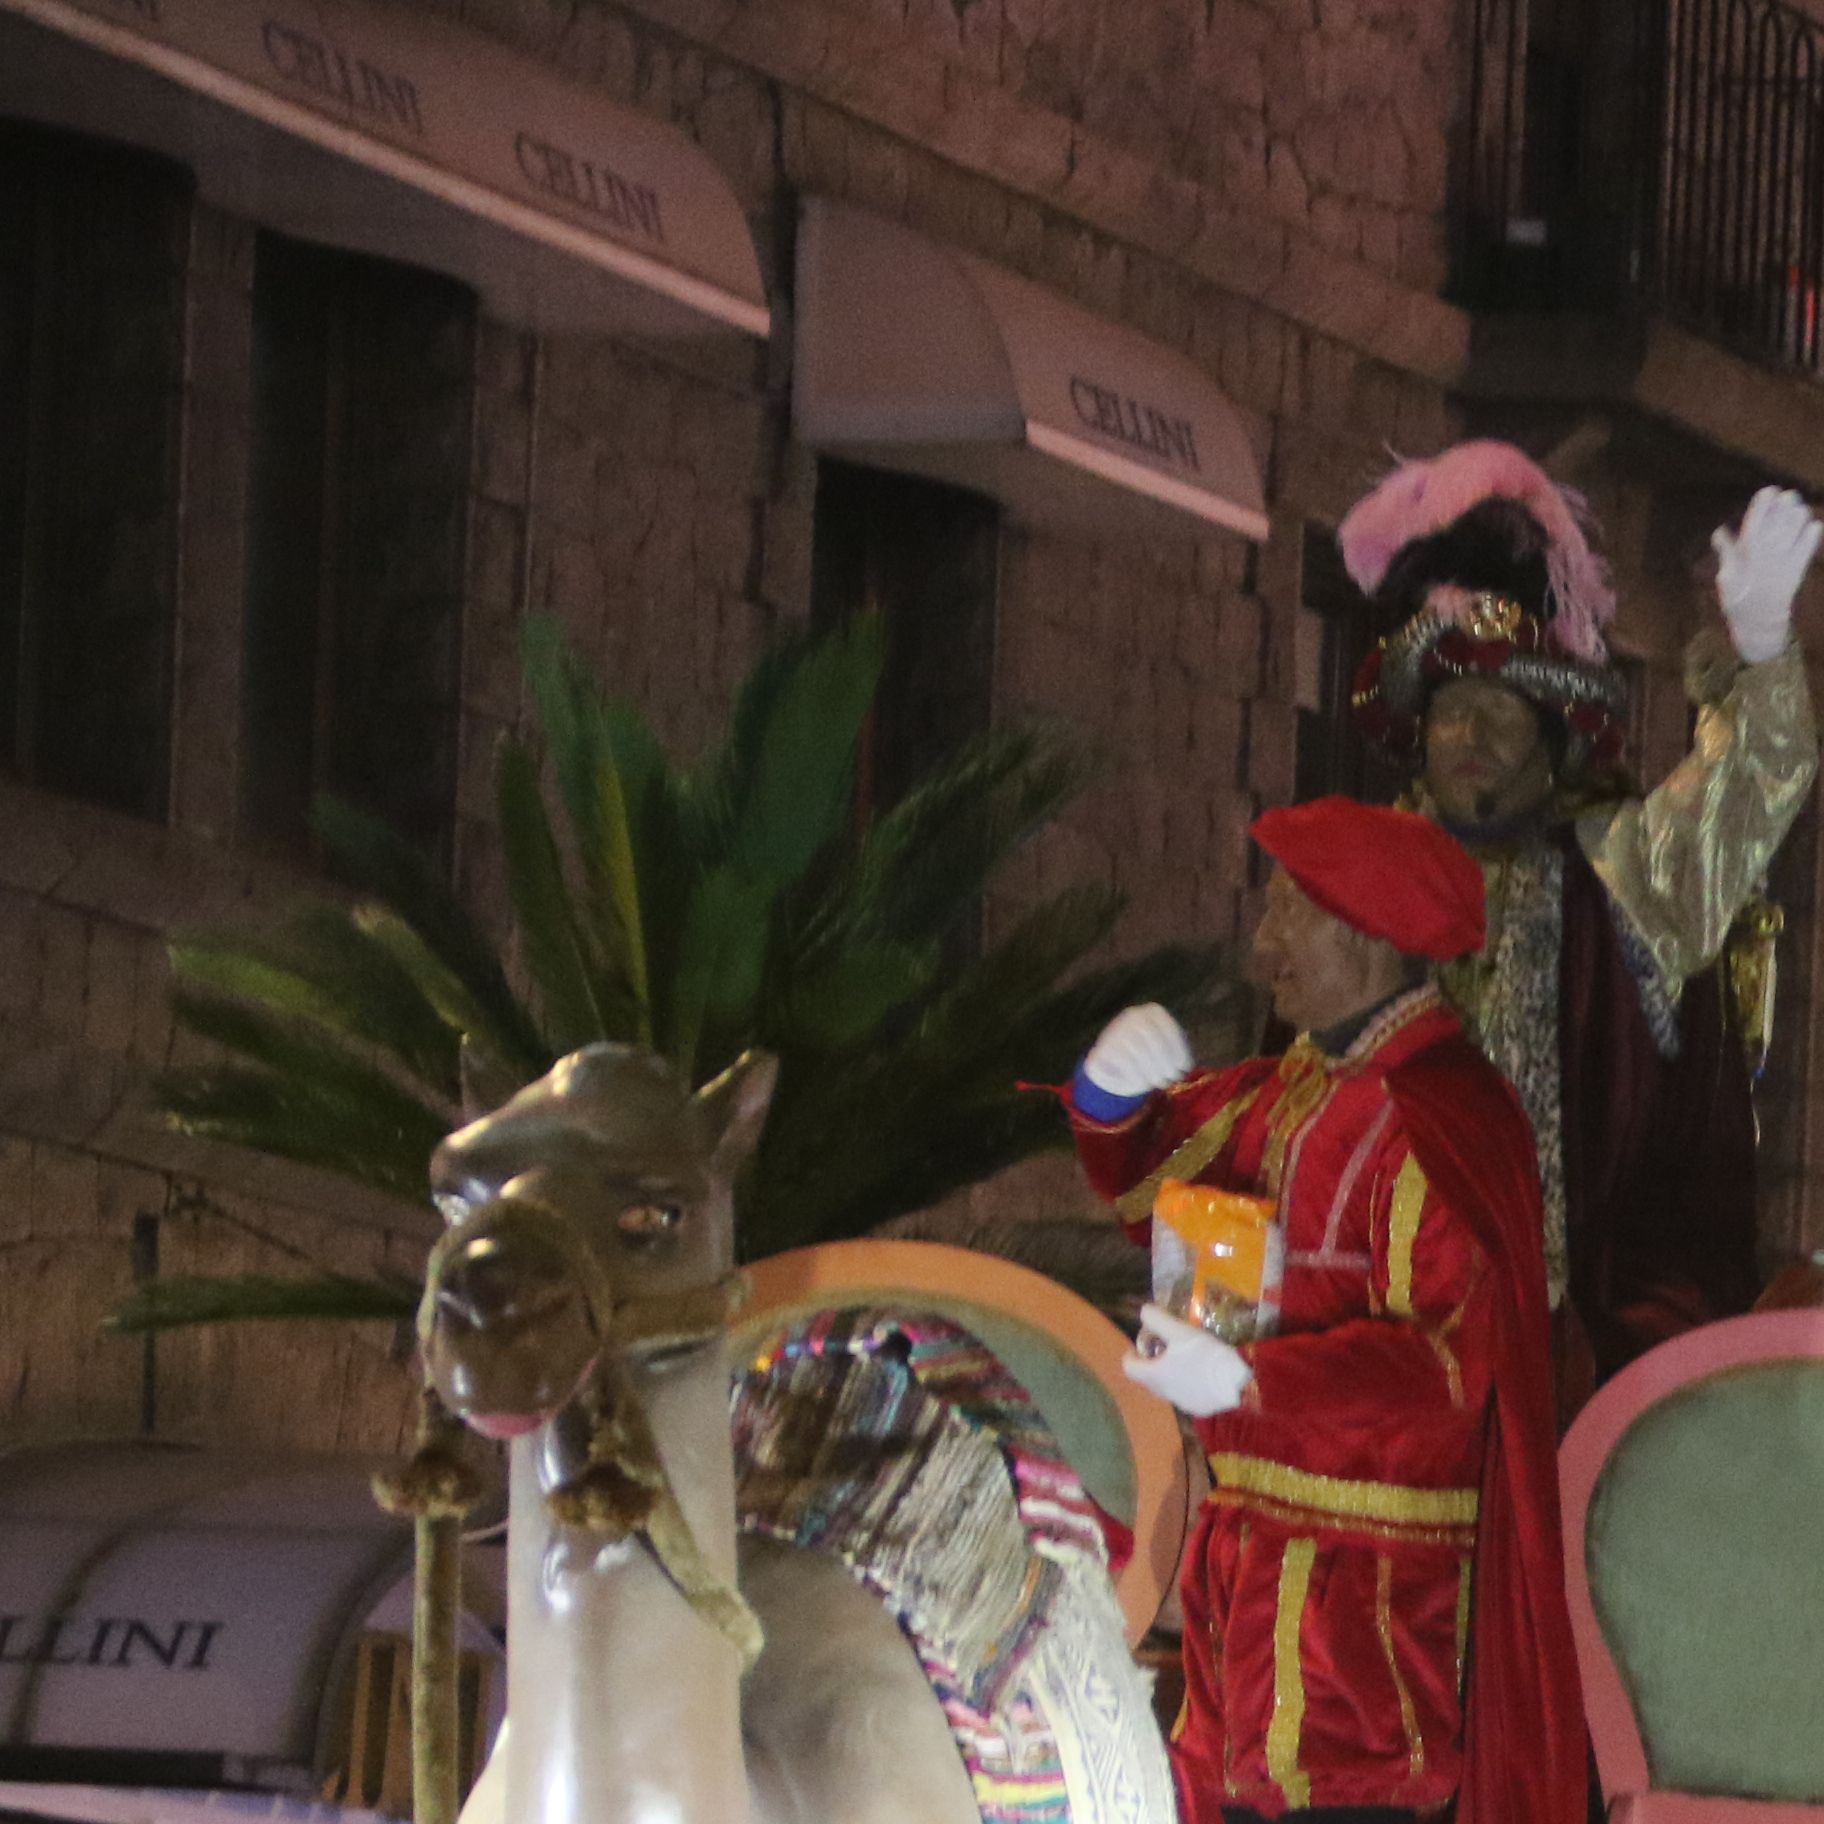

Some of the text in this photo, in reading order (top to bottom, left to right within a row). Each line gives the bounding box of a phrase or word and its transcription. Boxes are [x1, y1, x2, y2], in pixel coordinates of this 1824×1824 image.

[262, 18, 424, 138] CELLINI
[514, 130, 666, 245] CELLINI
[1070, 374, 1200, 471] CELLINI
